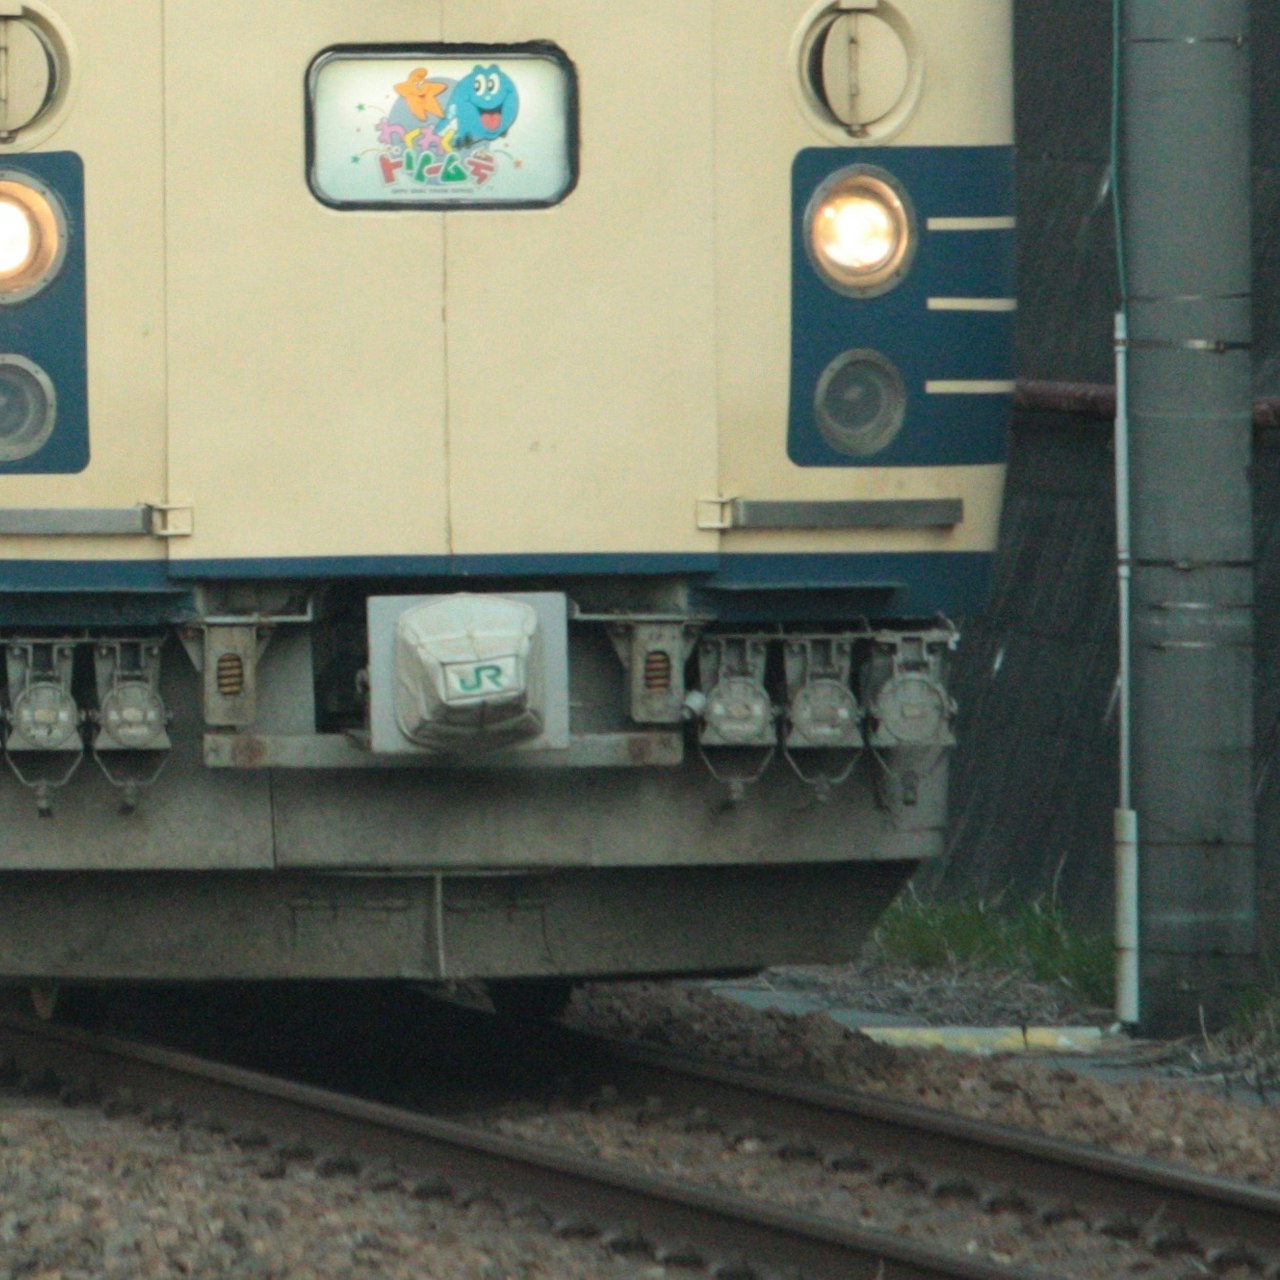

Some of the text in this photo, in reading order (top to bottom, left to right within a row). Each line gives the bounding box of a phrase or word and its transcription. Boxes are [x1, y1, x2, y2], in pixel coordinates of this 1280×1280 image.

[376, 118, 457, 155] わくわく
[459, 664, 503, 692] JR
